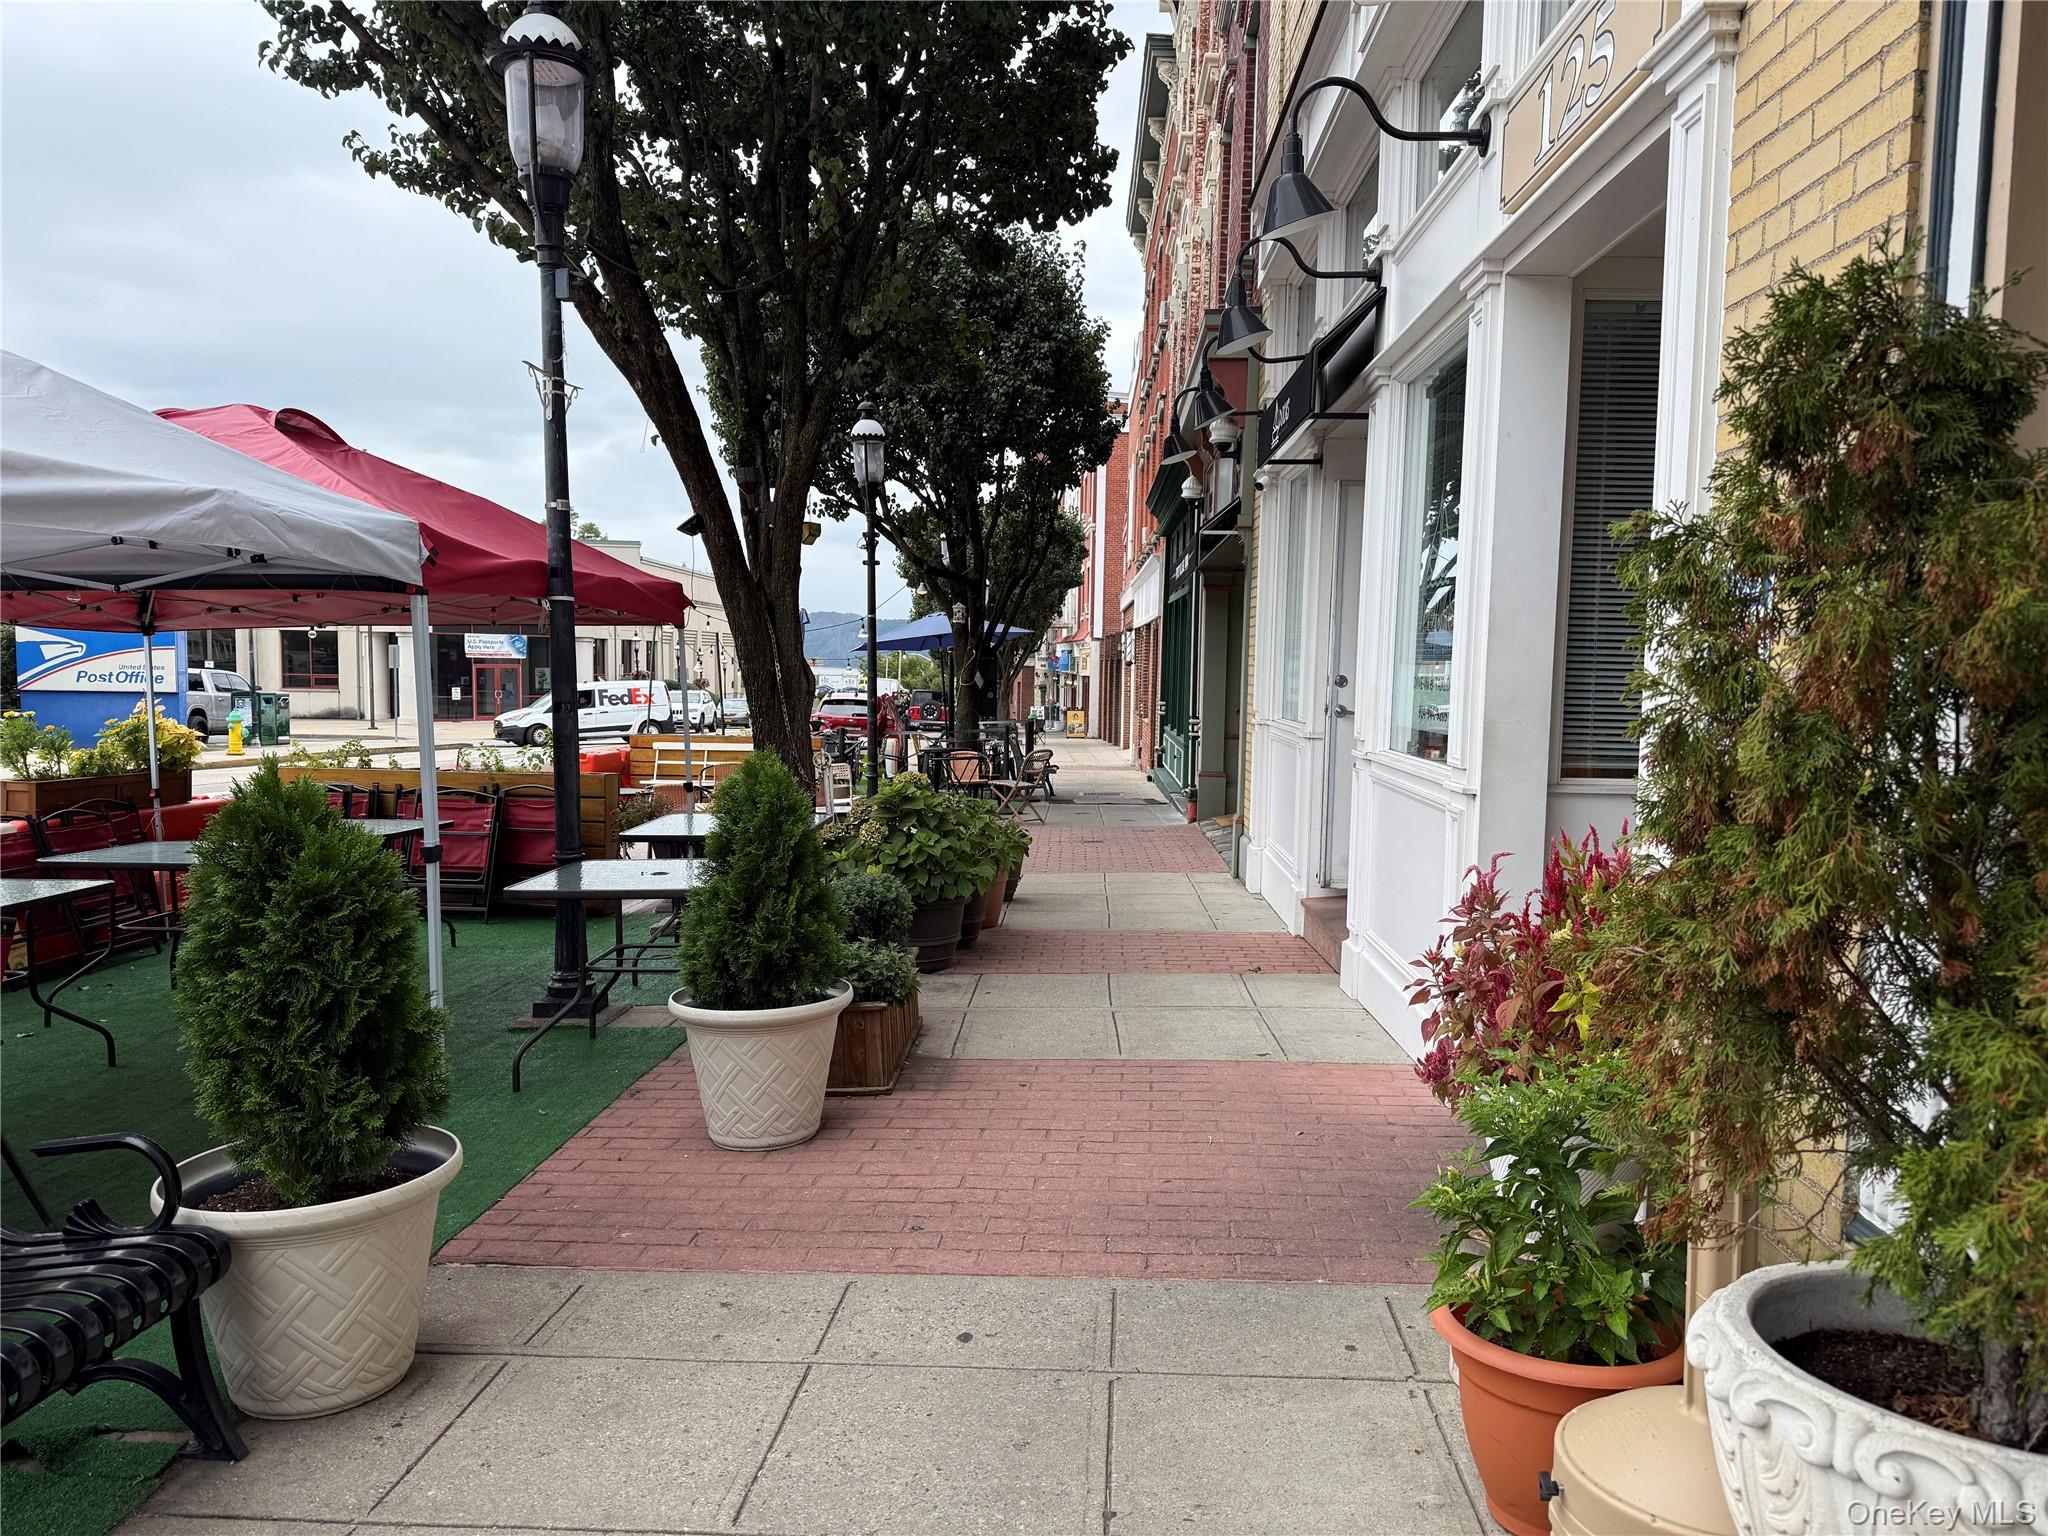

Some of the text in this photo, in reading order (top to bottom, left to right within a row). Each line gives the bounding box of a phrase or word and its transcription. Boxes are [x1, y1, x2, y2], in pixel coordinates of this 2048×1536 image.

[1534, 0, 1616, 167] 125
[76, 670, 164, 684] Post Offie
[597, 688, 656, 706] FedEx
